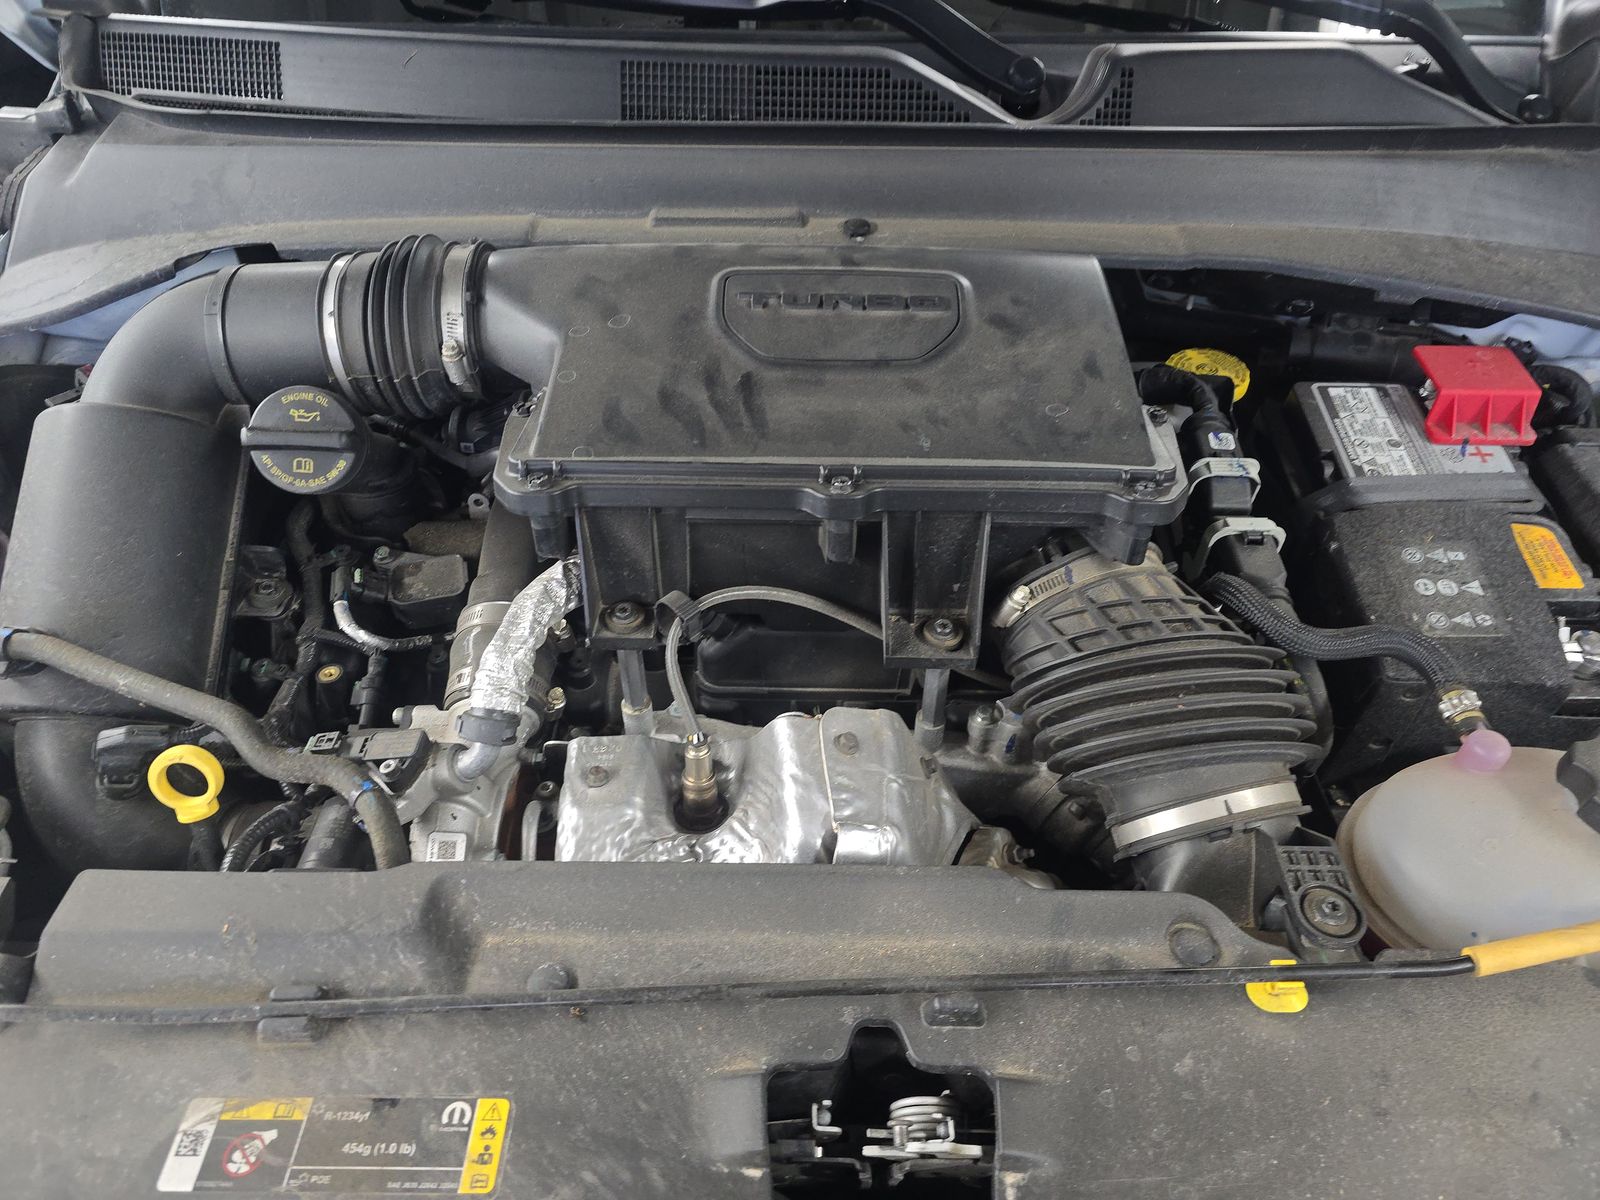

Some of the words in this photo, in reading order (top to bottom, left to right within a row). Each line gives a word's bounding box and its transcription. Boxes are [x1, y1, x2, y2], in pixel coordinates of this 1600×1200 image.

[281, 392, 314, 405] ENGINE
[316, 393, 329, 407] OIL
[261, 454, 273, 469] API
[341, 1143, 372, 1156] 454g
[374, 1143, 397, 1156] (1.0
[399, 1143, 417, 1156] lb)
